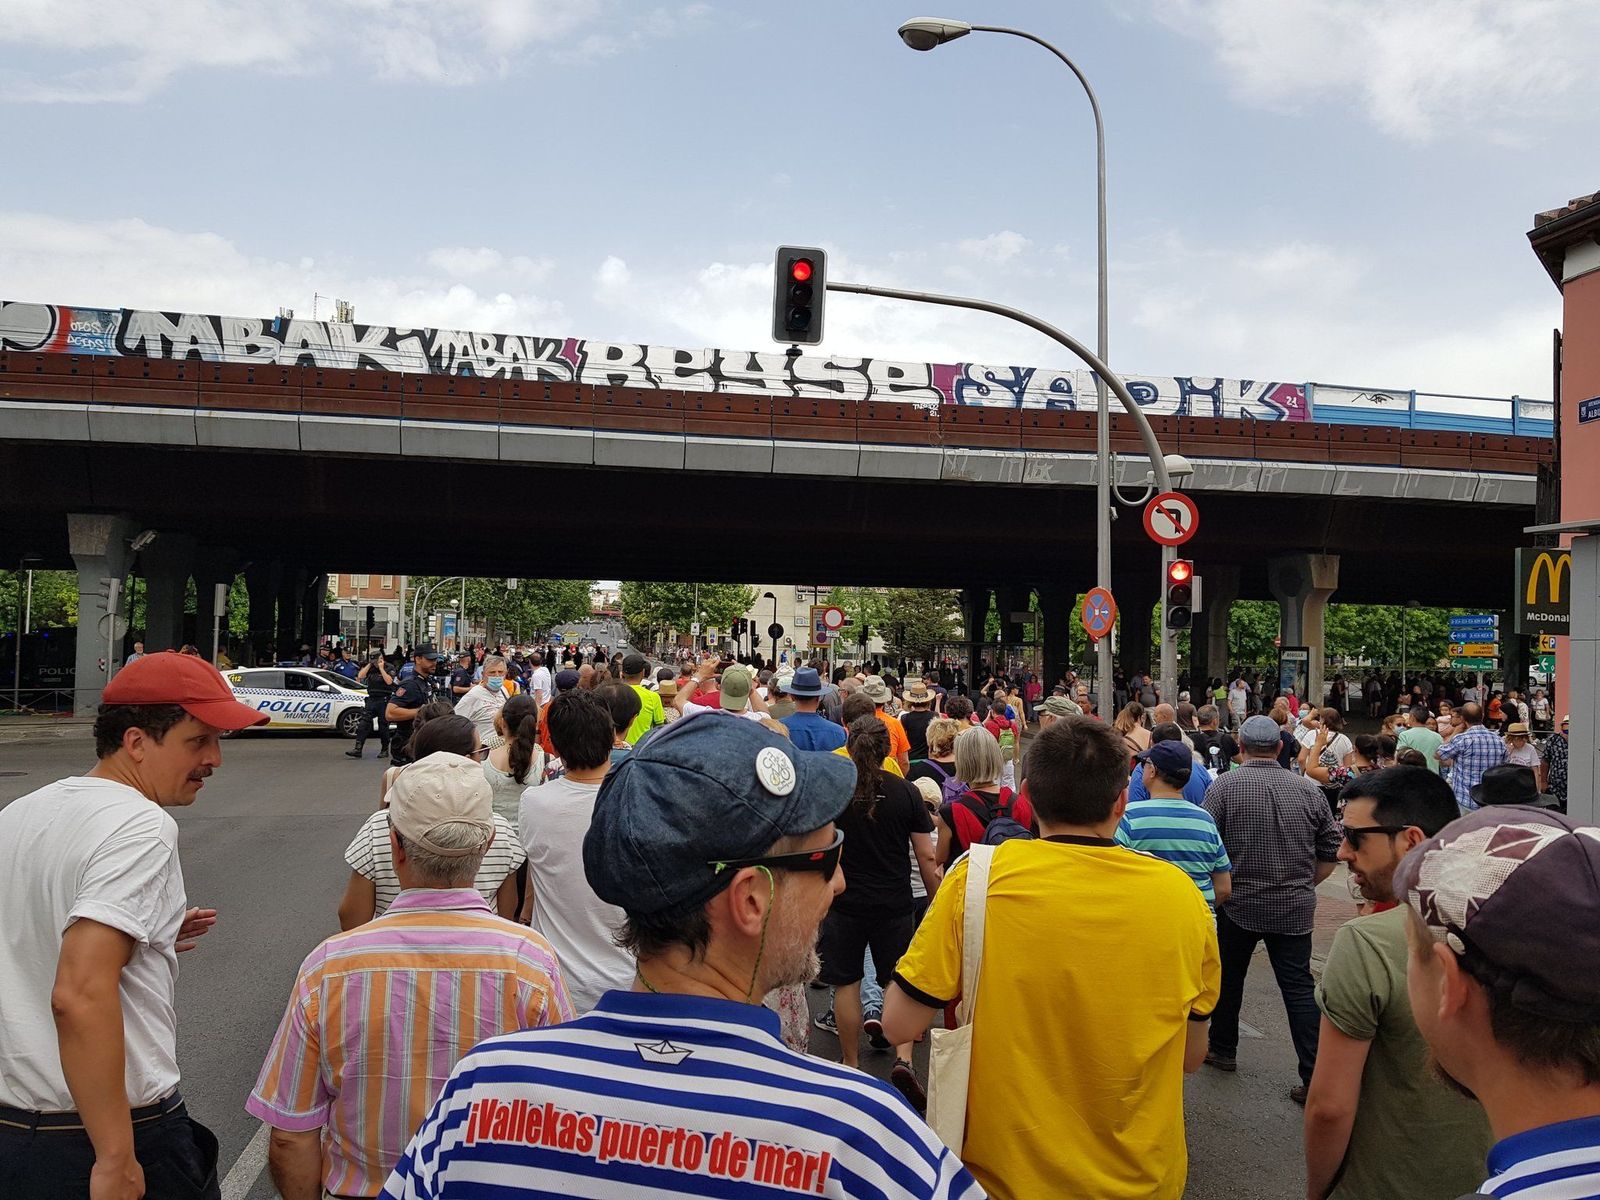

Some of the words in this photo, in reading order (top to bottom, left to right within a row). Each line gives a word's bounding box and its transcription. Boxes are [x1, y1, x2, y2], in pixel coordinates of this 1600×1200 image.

[1527, 612, 1570, 623] McDonal
[466, 1098, 595, 1153] ¡Vallekas
[598, 1117, 708, 1171] puerto
[709, 1131, 752, 1178] de
[753, 1143, 832, 1194] mar!
